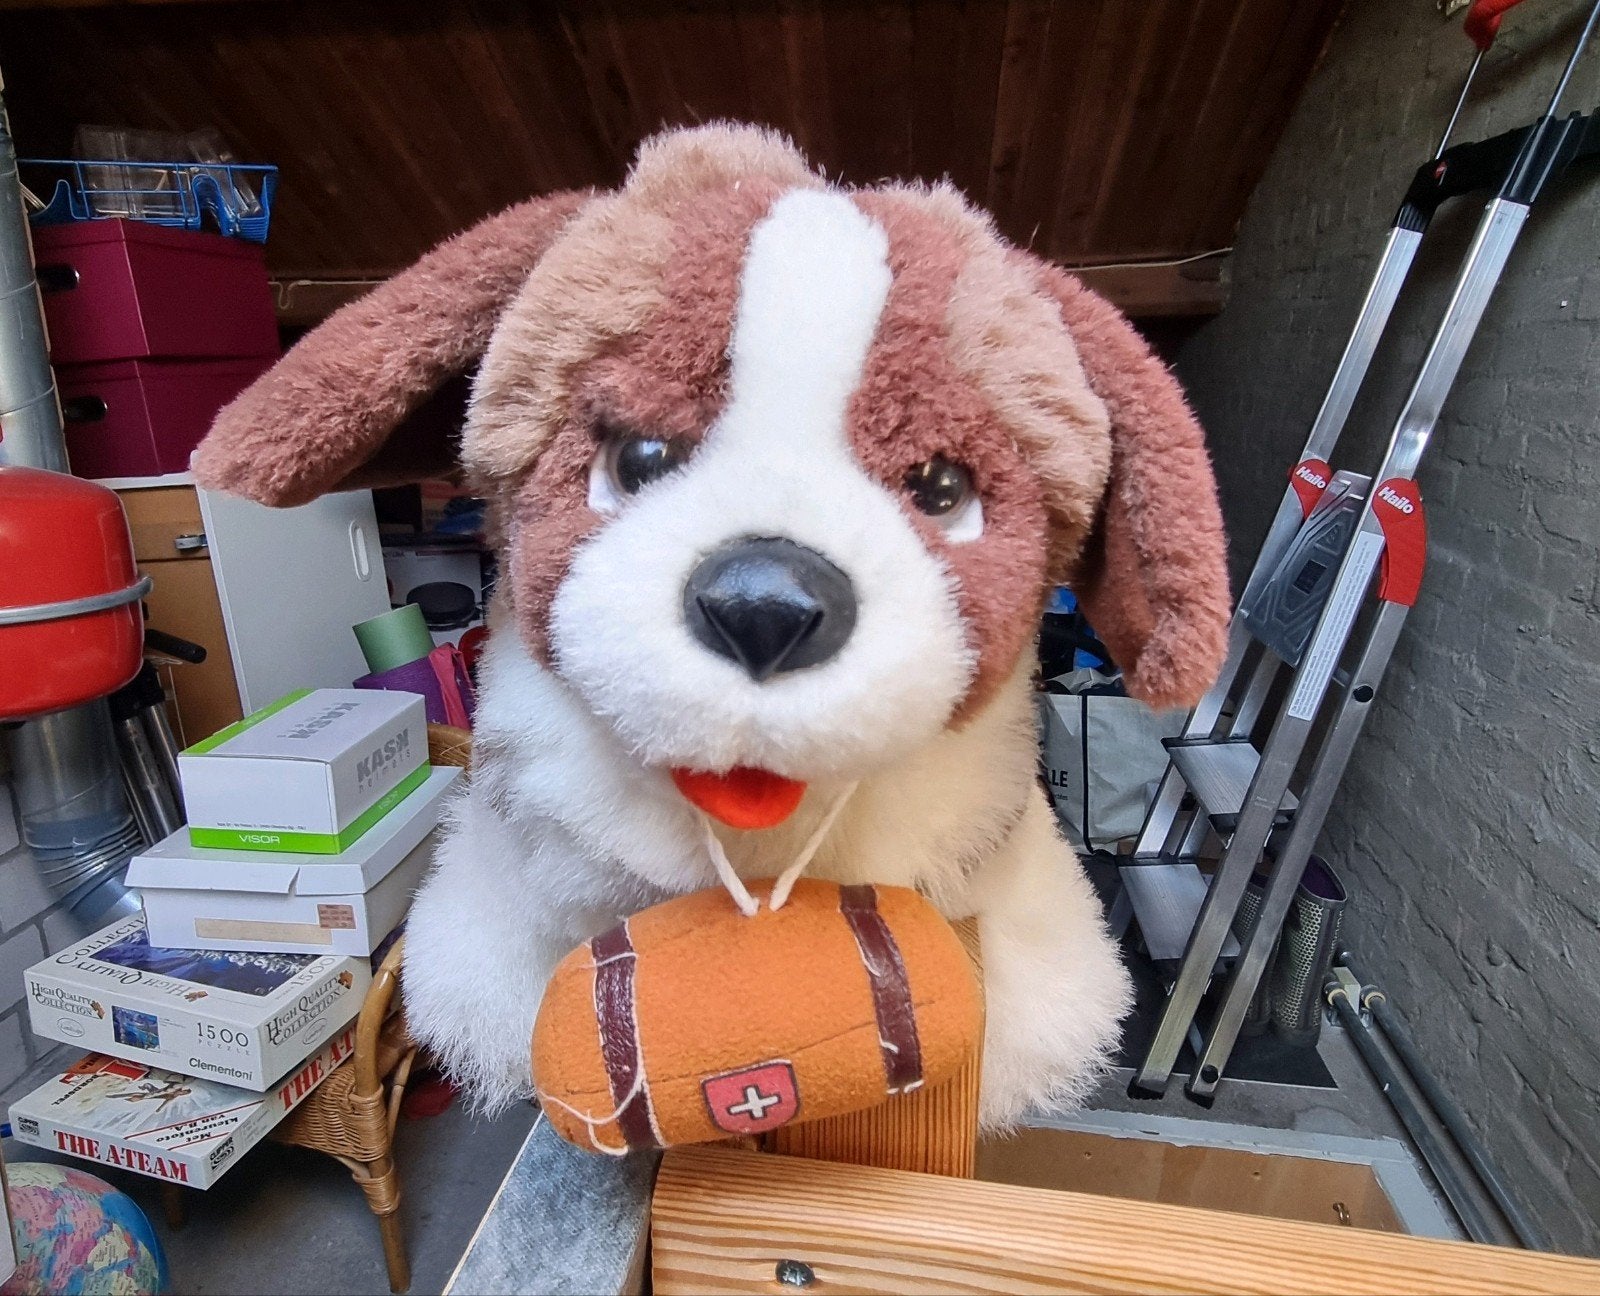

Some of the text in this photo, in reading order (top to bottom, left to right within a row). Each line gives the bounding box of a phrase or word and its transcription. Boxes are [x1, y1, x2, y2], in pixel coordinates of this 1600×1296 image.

[1295, 465, 1327, 489] Hailo
[1377, 485, 1415, 514] Hailo
[355, 728, 410, 784] KASK
[1049, 769, 1069, 788] LE
[239, 834, 281, 844] VISOR
[56, 916, 145, 965] COLLECTI
[72, 961, 192, 997] HIGH QUALITY
[290, 957, 336, 986] 1500
[31, 981, 92, 1005] HIGH QUALITY
[35, 994, 93, 1016] COLLECTION
[266, 1007, 298, 1043] HIGH
[298, 977, 338, 1012] QUALITY
[272, 986, 341, 1046] COLLECTION
[197, 1022, 249, 1047] 1500
[189, 1057, 253, 1081] Clementoni
[278, 1054, 325, 1111] THE
[156, 1117, 238, 1142] kleurenfoto
[201, 1114, 226, 1123] van
[186, 1131, 211, 1142] Met
[209, 1137, 234, 1161] CLIPPER
[53, 1129, 189, 1183] THE A-TEAM
